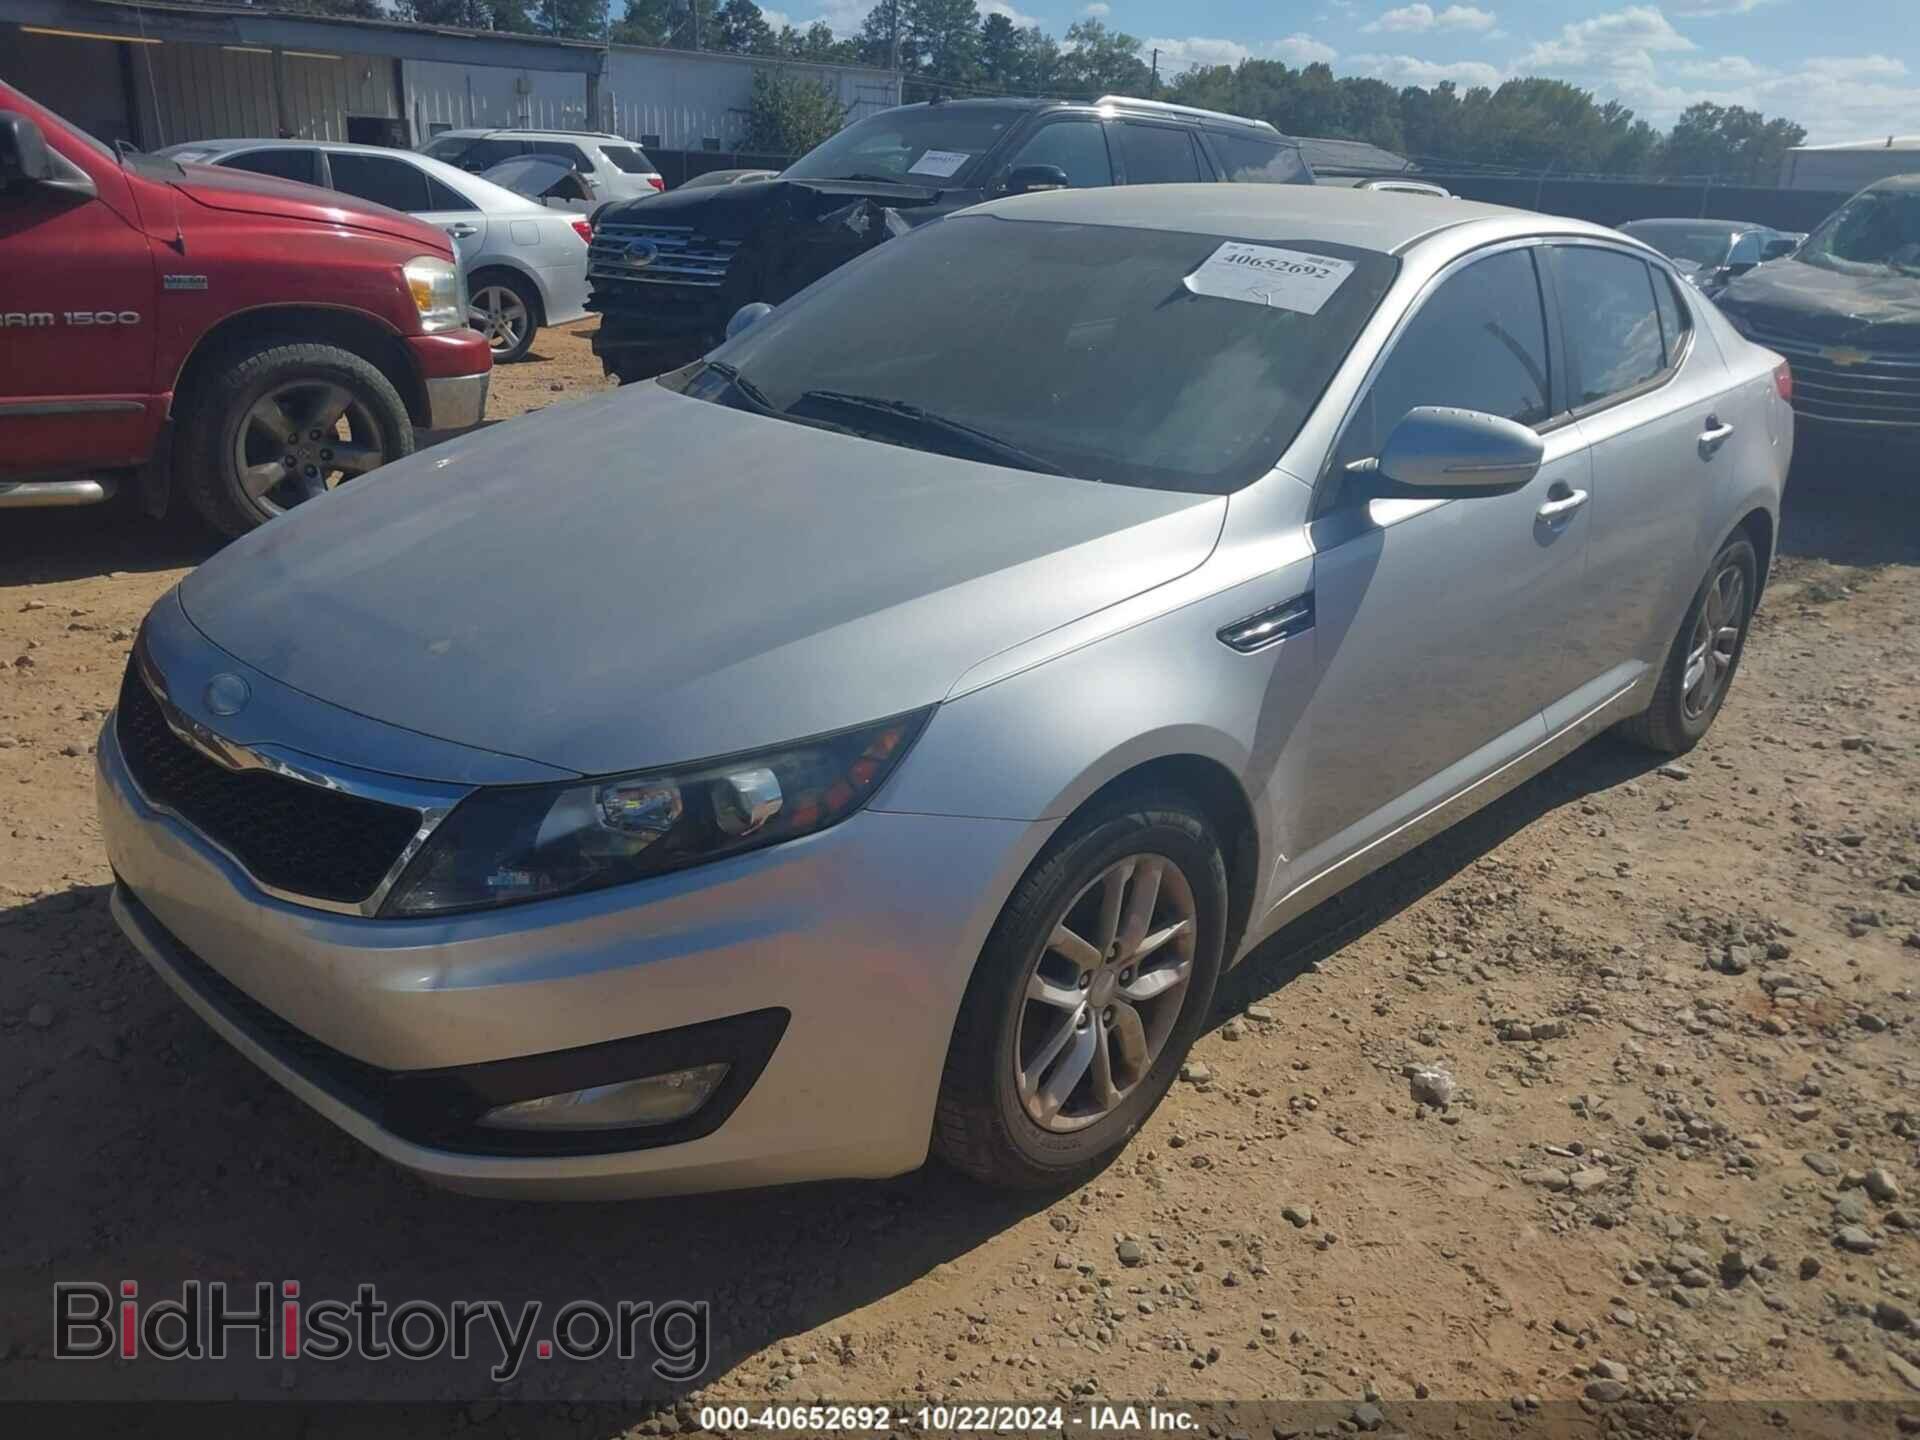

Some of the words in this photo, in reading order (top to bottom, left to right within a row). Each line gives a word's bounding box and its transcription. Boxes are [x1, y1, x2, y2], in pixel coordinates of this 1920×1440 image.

[1223, 253, 1332, 279] 40652692
[0, 312, 56, 327] AM
[64, 311, 141, 325] 1500
